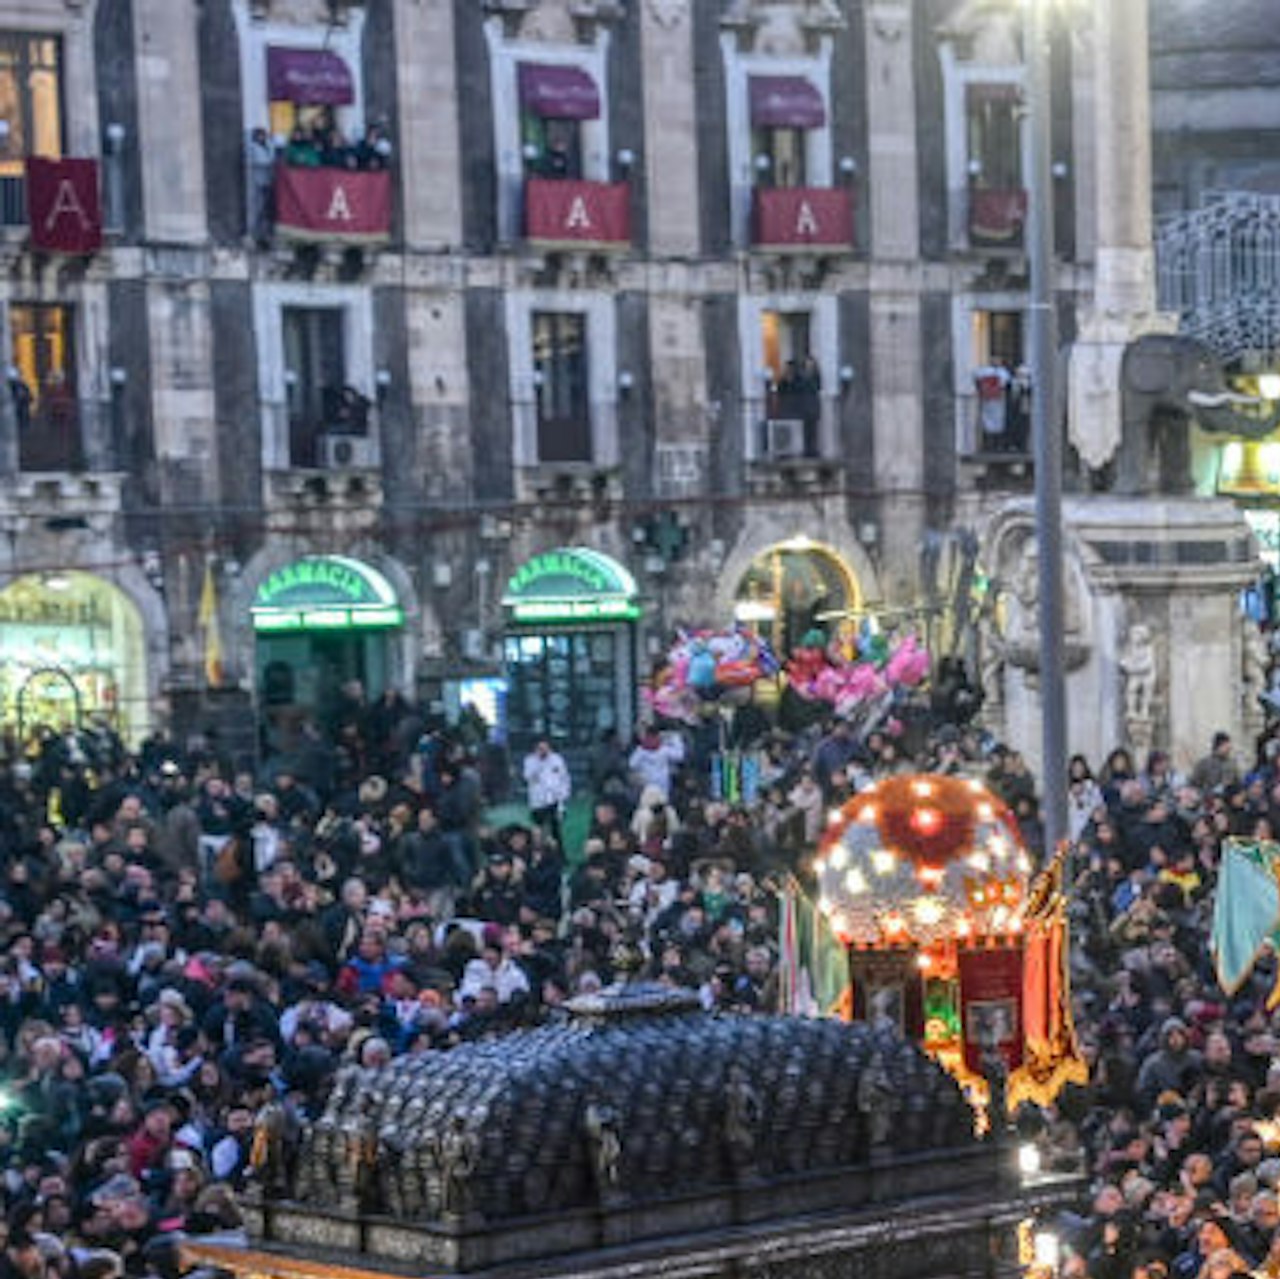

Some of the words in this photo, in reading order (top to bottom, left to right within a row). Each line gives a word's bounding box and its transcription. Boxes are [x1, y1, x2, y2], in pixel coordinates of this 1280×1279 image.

[46, 180, 90, 230] A
[327, 186, 353, 220] A
[565, 196, 591, 228] A
[796, 201, 817, 235] A
[257, 562, 363, 602] FARMACIA
[509, 553, 606, 591] FARMACIA
